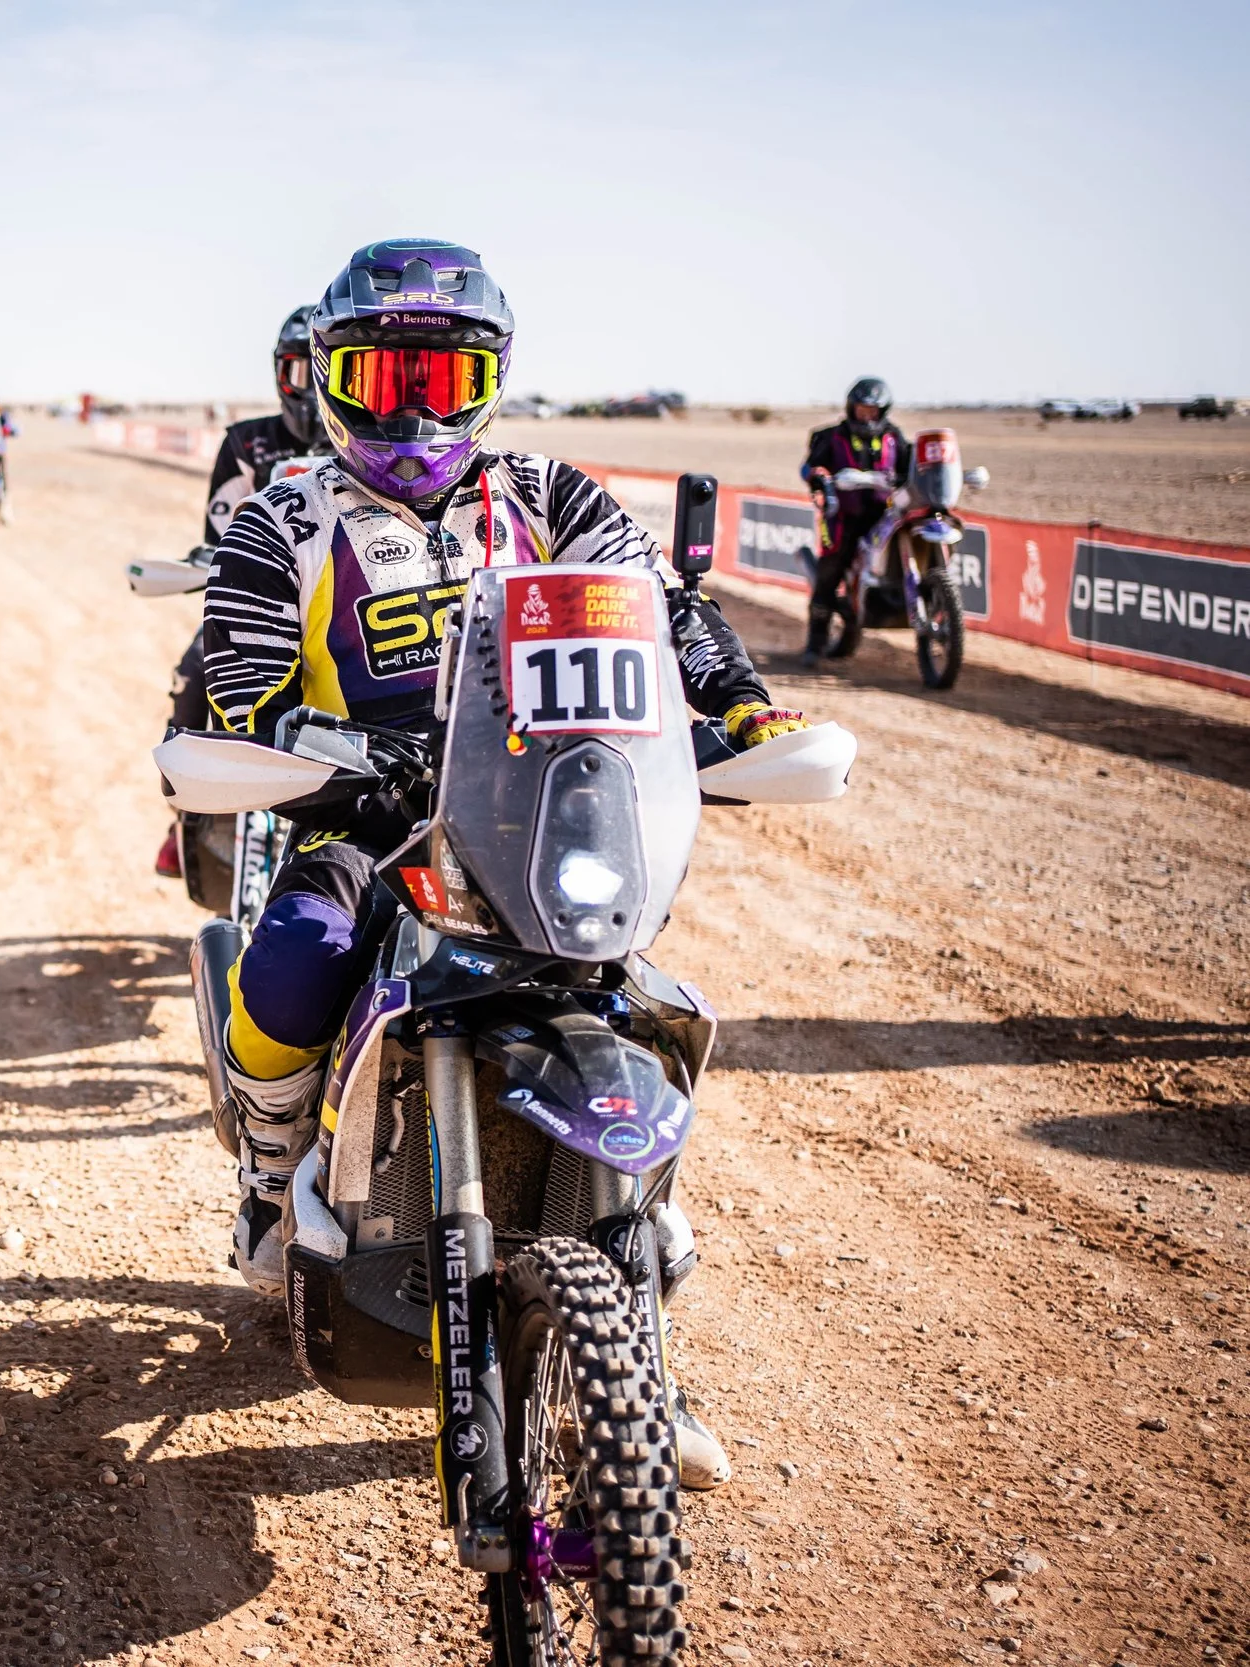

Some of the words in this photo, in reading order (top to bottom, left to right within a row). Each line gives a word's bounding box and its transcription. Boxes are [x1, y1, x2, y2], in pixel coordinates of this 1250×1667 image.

[403, 313, 451, 326] Bennetts
[373, 545, 411, 559] DMJ
[381, 555, 407, 564] Electrical
[584, 584, 640, 600] DREAM.
[585, 599, 631, 613] DARE.
[1072, 574, 1250, 640] DEFENDER
[586, 613, 622, 627] LIVE
[622, 614, 639, 628] IT.
[405, 645, 442, 665] RAC
[526, 647, 646, 722] 110
[443, 917, 489, 936] SEARLES
[449, 953, 496, 974] HELITE
[526, 1100, 573, 1135] Bennetts
[444, 1229, 474, 1416] METZELER
